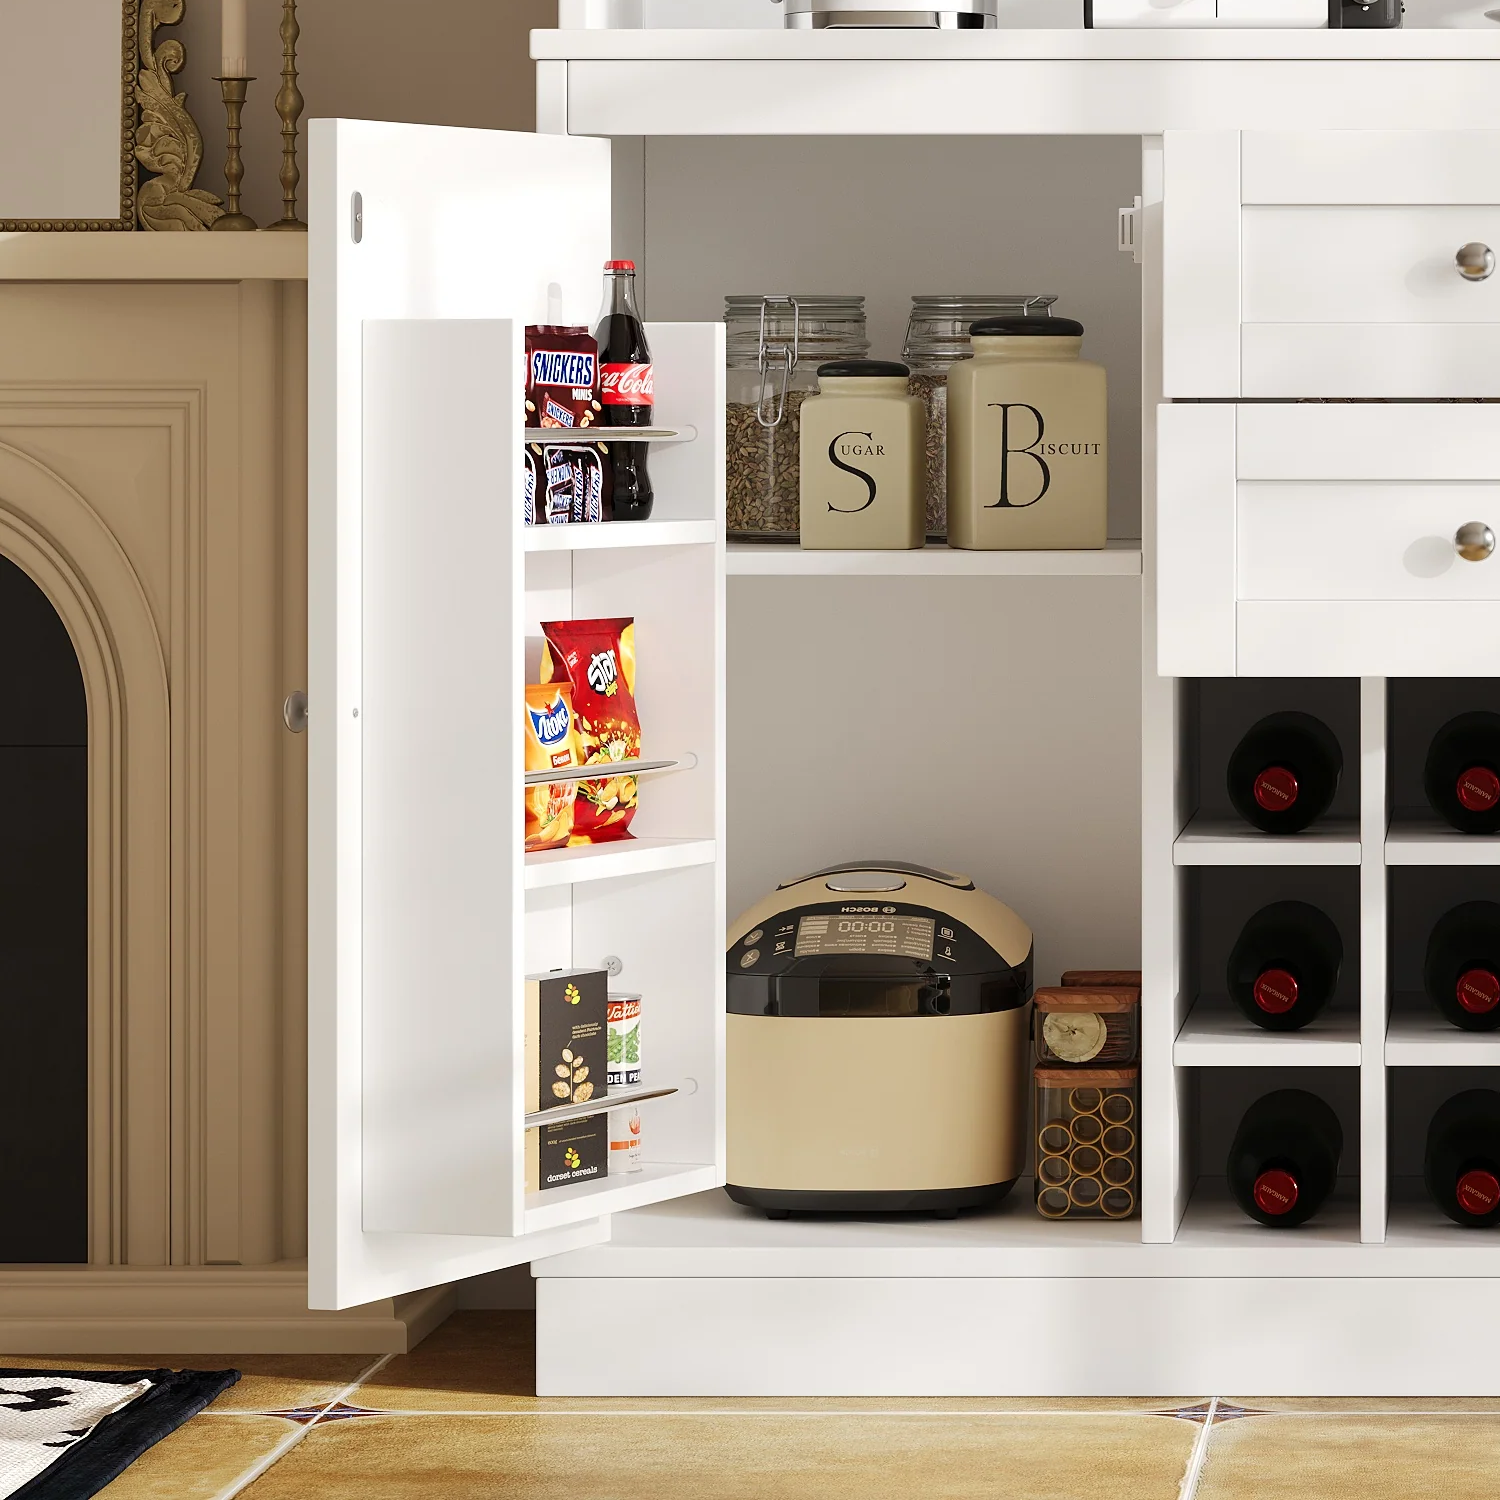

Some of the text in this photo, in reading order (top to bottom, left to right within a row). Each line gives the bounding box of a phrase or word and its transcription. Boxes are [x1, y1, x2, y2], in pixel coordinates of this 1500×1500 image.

[533, 352, 592, 386] SNICKERS
[572, 388, 592, 401] MINIS
[547, 402, 574, 428] SNICKERS
[984, 403, 1101, 508] BISCUIT
[827, 431, 886, 513] SUGAR
[538, 708, 569, 740] Люкс
[1262, 781, 1288, 800] MARGAUX
[1464, 781, 1491, 800] MARGAUX
[1262, 984, 1288, 1002] MARGAUX
[1464, 984, 1491, 1002] MARGAUX
[608, 1074, 626, 1084] DEN
[546, 1166, 598, 1183] dorset cereals
[1262, 1184, 1288, 1204] MARGAUX
[1464, 1184, 1491, 1204] MARGAUX
